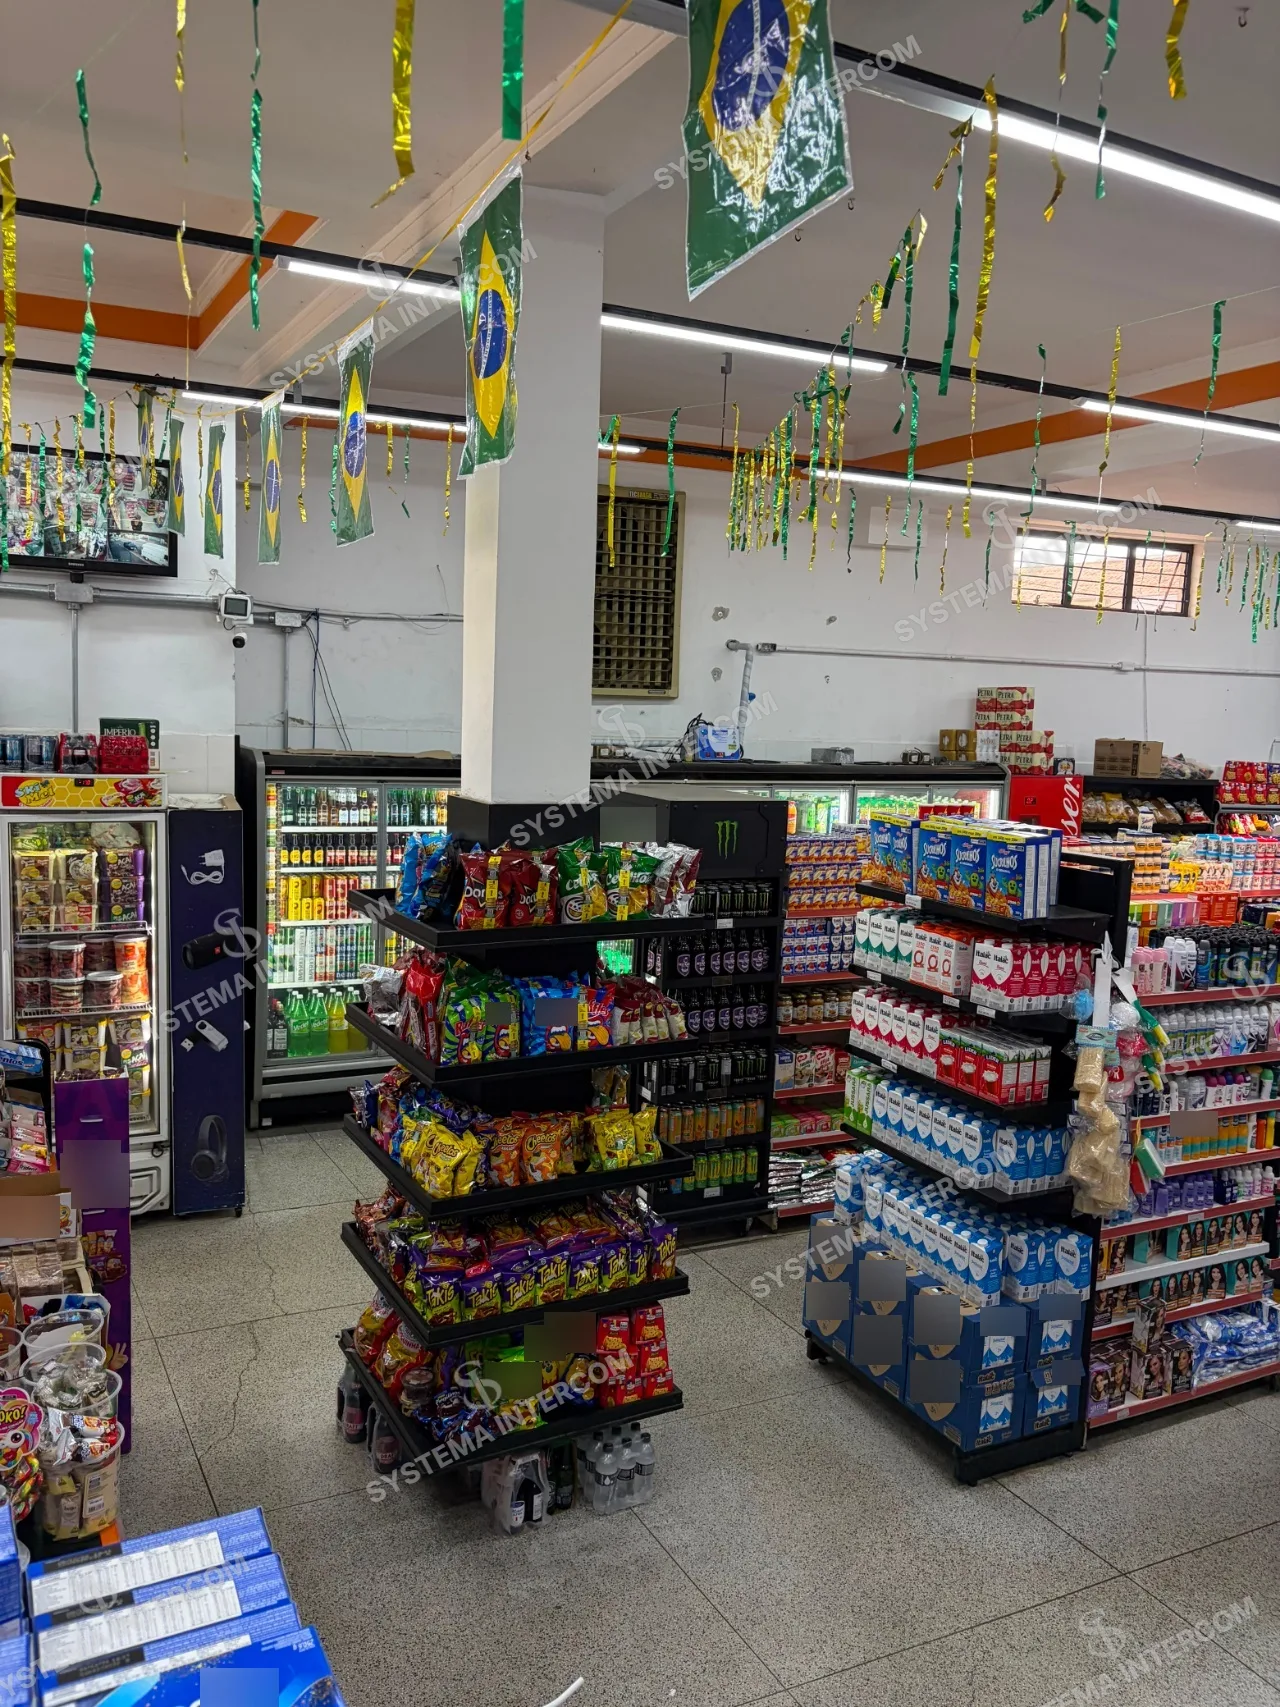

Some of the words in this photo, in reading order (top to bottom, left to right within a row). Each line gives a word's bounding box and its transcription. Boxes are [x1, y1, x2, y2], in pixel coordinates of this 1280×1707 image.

[997, 690, 1015, 699] PETRA
[996, 712, 1014, 721] PETRA
[1000, 733, 1013, 742] ETRA
[1016, 733, 1032, 742] PETRA
[1016, 755, 1033, 764] PETRA
[976, 950, 992, 960] Italac
[994, 954, 1008, 964] Italac
[526, 1132, 558, 1150] Cheetos
[1060, 1246, 1076, 1258] Italac
[539, 1260, 568, 1287] Takis
[427, 1284, 454, 1308] Takis
[506, 1276, 535, 1306] Takis
